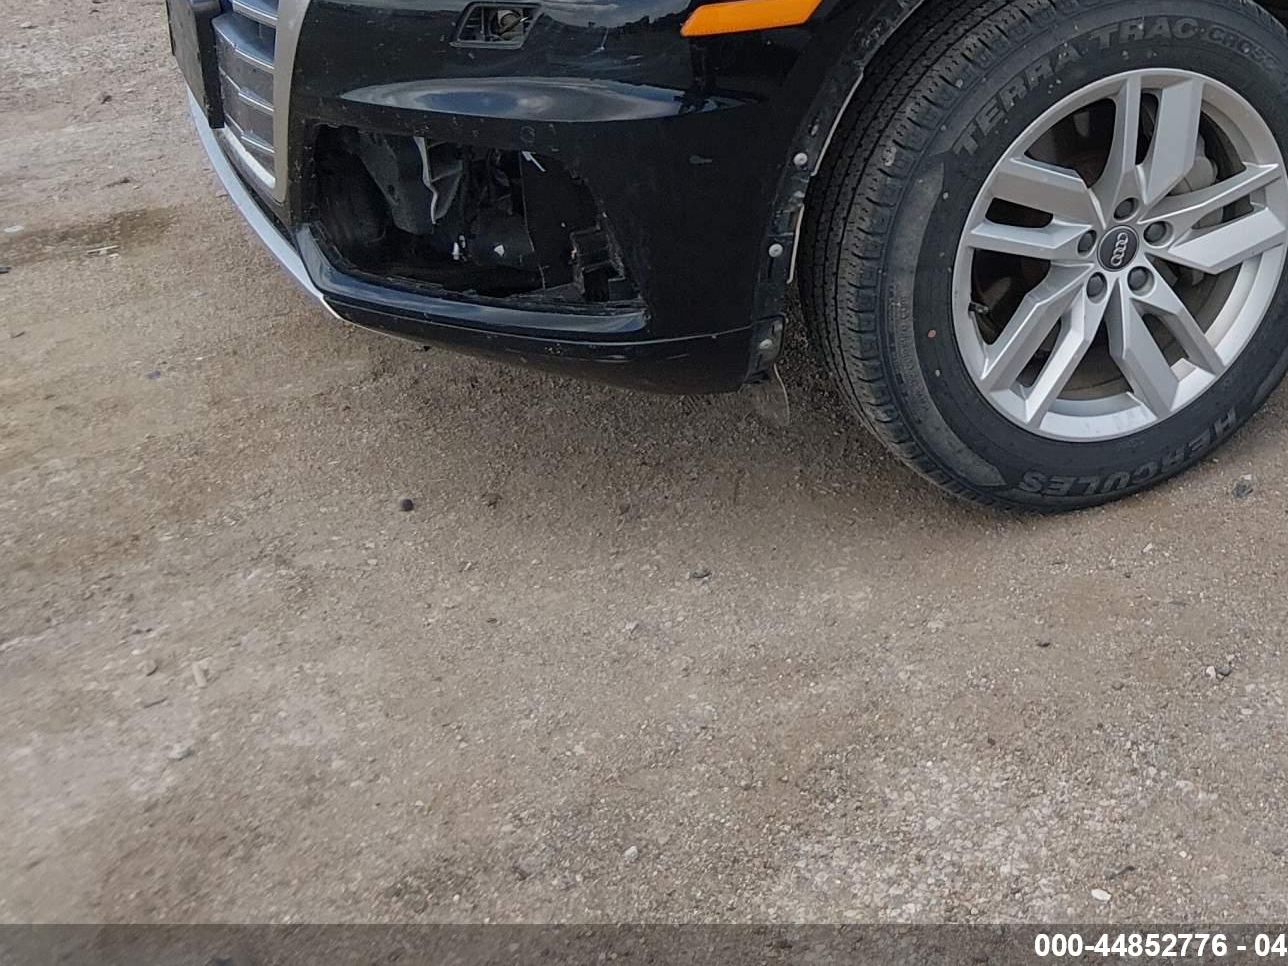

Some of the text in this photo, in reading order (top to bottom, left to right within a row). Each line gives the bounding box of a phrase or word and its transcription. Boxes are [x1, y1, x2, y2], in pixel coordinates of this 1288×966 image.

[952, 42, 1082, 156] TERRA
[1089, 17, 1198, 49] TRAC
[1018, 406, 1238, 496] HERCULES
